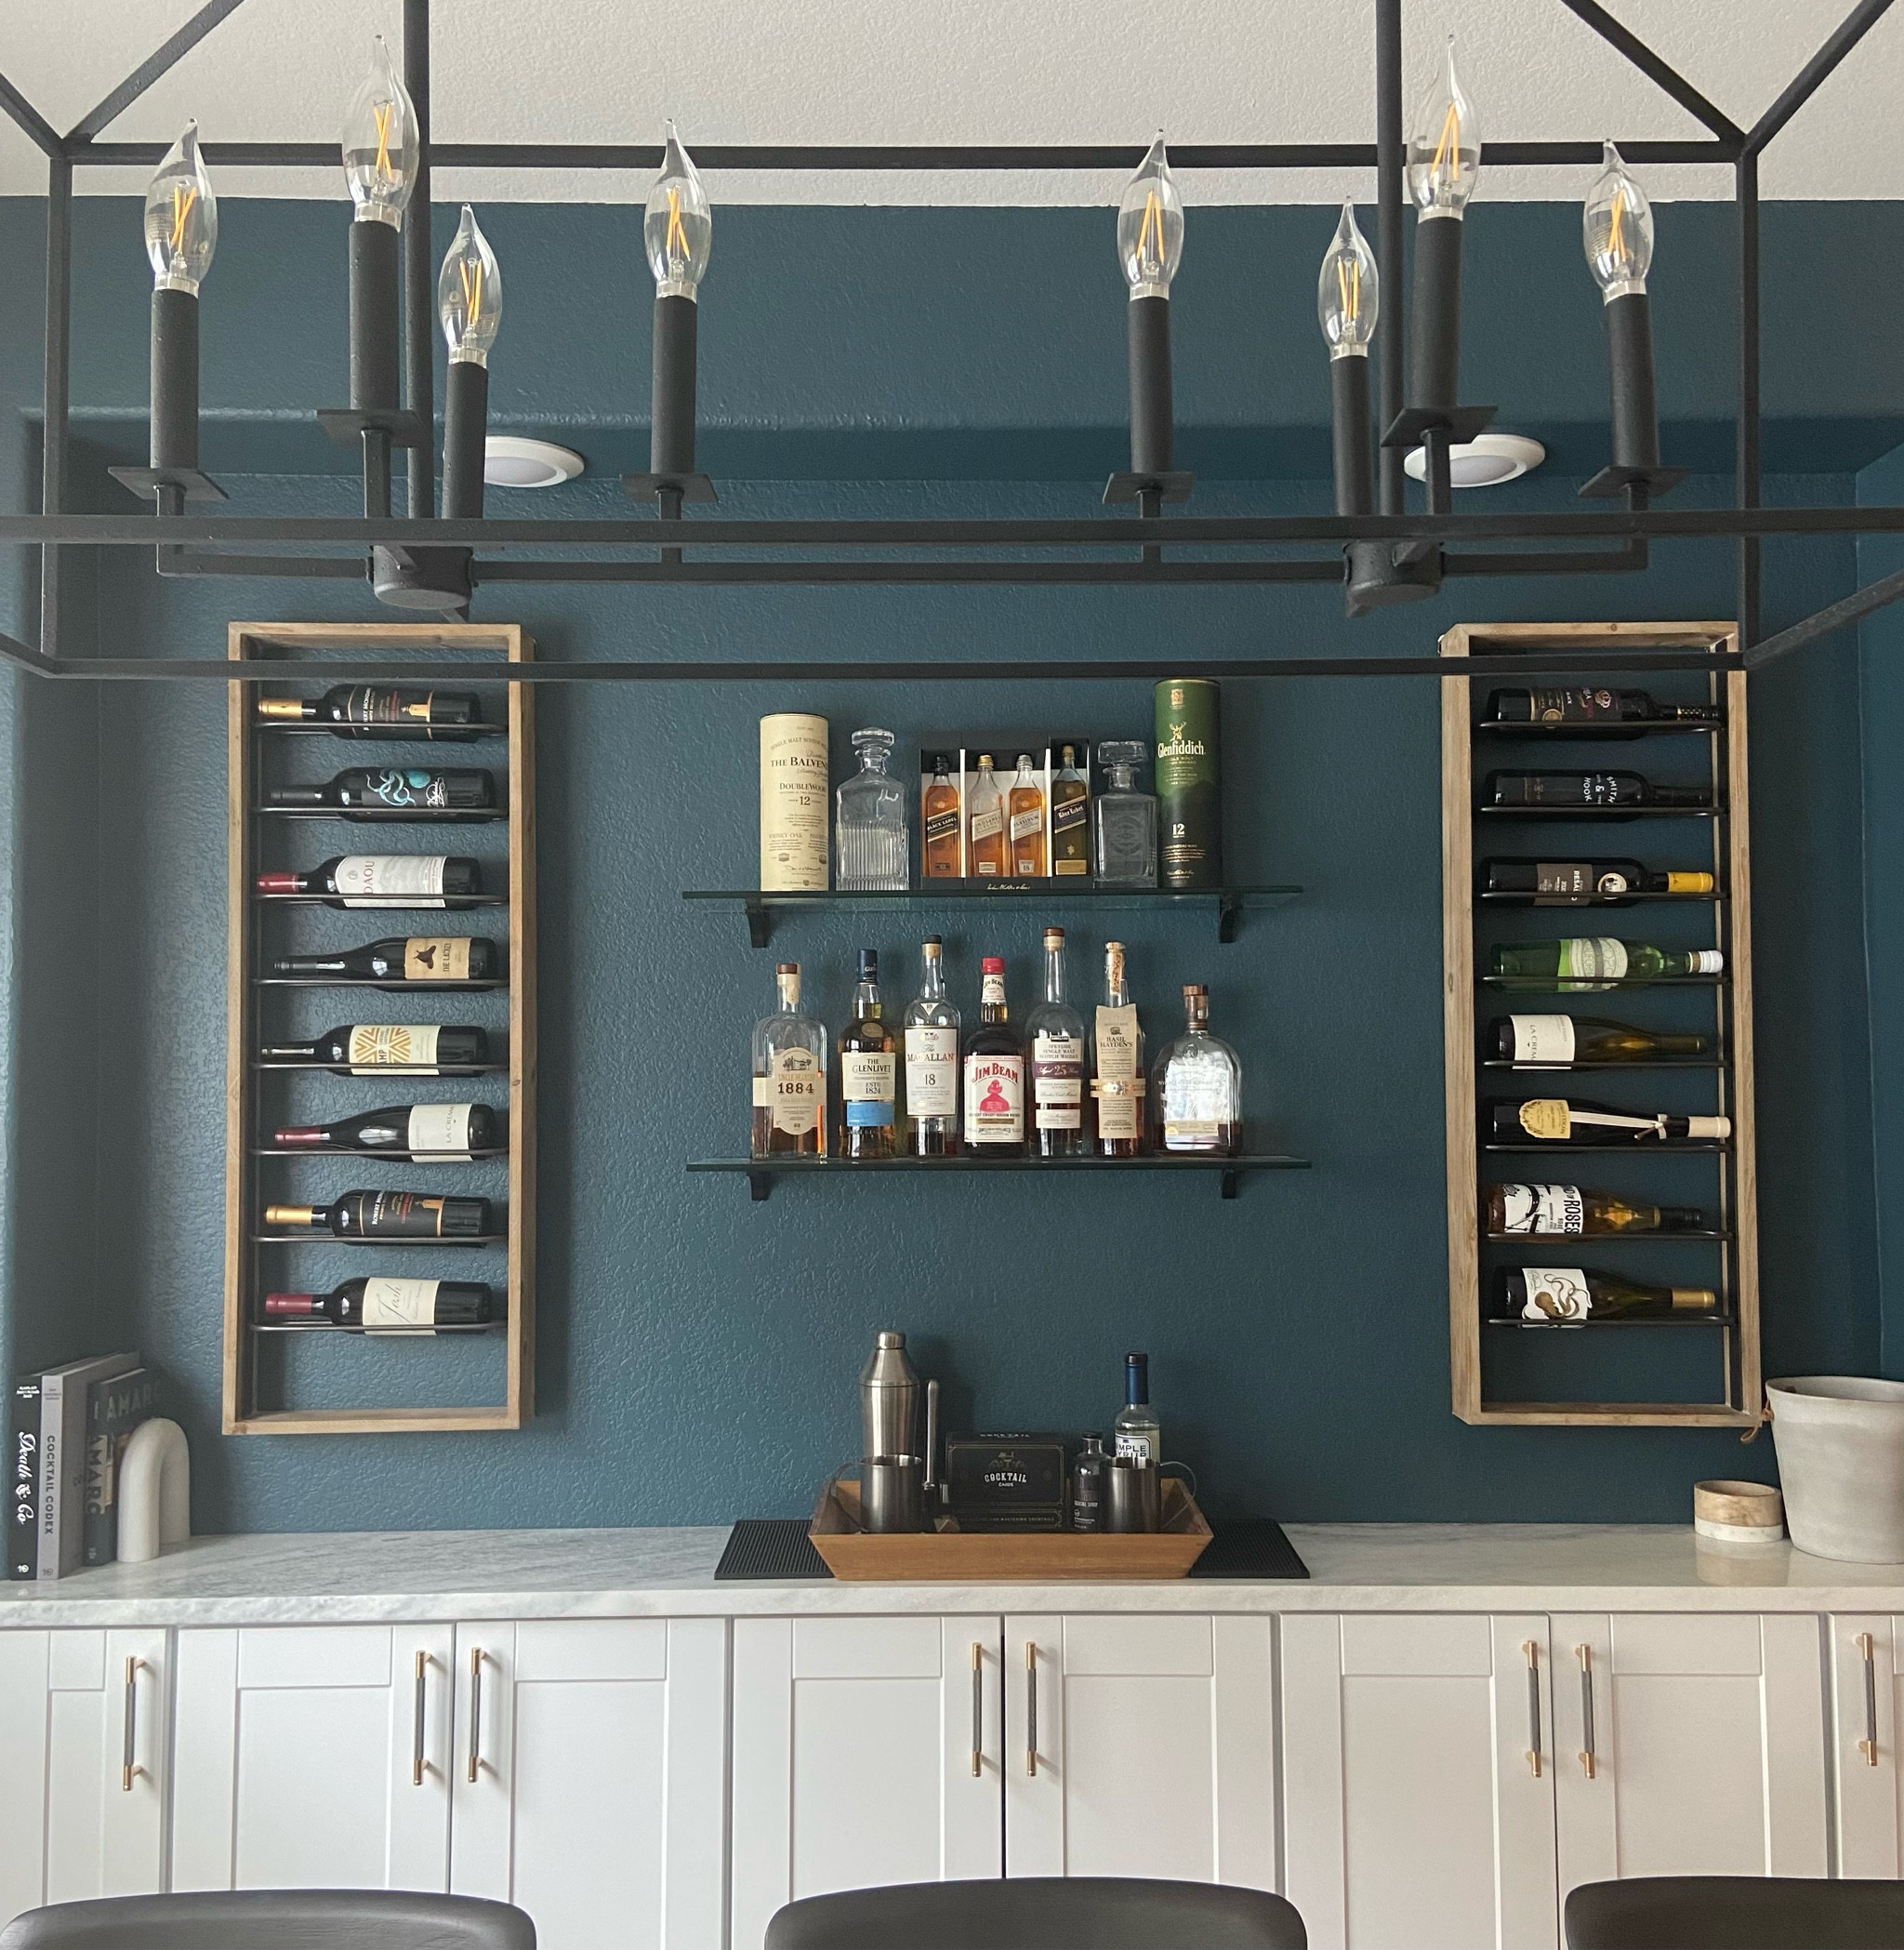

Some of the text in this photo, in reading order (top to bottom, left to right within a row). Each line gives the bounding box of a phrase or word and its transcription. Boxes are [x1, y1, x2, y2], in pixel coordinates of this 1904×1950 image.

[1157, 739, 1204, 758] Glenfiddich
[771, 759, 787, 767] THE
[1583, 776, 1593, 802] HOOK
[1594, 784, 1605, 792] &
[1606, 776, 1617, 803] SMITH
[800, 796, 811, 806] 12
[942, 816, 958, 826] LABEL
[1172, 823, 1185, 835] 12
[364, 860, 375, 894] DAOU
[1529, 1024, 1536, 1034] LA
[922, 1043, 935, 1053] The
[907, 1053, 955, 1062] MACALLAN
[852, 1064, 892, 1073] GLENLIVET
[972, 1063, 1019, 1084] JIM BEAM
[1053, 1064, 1067, 1076] 25
[924, 1073, 936, 1086] 18
[777, 1081, 814, 1094] 1884
[445, 1106, 456, 1144] LA CREMA
[371, 1203, 380, 1226] ROBERT
[1563, 1200, 1581, 1234] ROSES
[377, 1283, 412, 1324] Josh
[1117, 1444, 1146, 1453] MPLE
[18, 1431, 36, 1480] Death
[984, 1472, 1027, 1483] COCKTAIL
[44, 1435, 56, 1535] COCKTAIL CODEX
[15, 1483, 32, 1501] &
